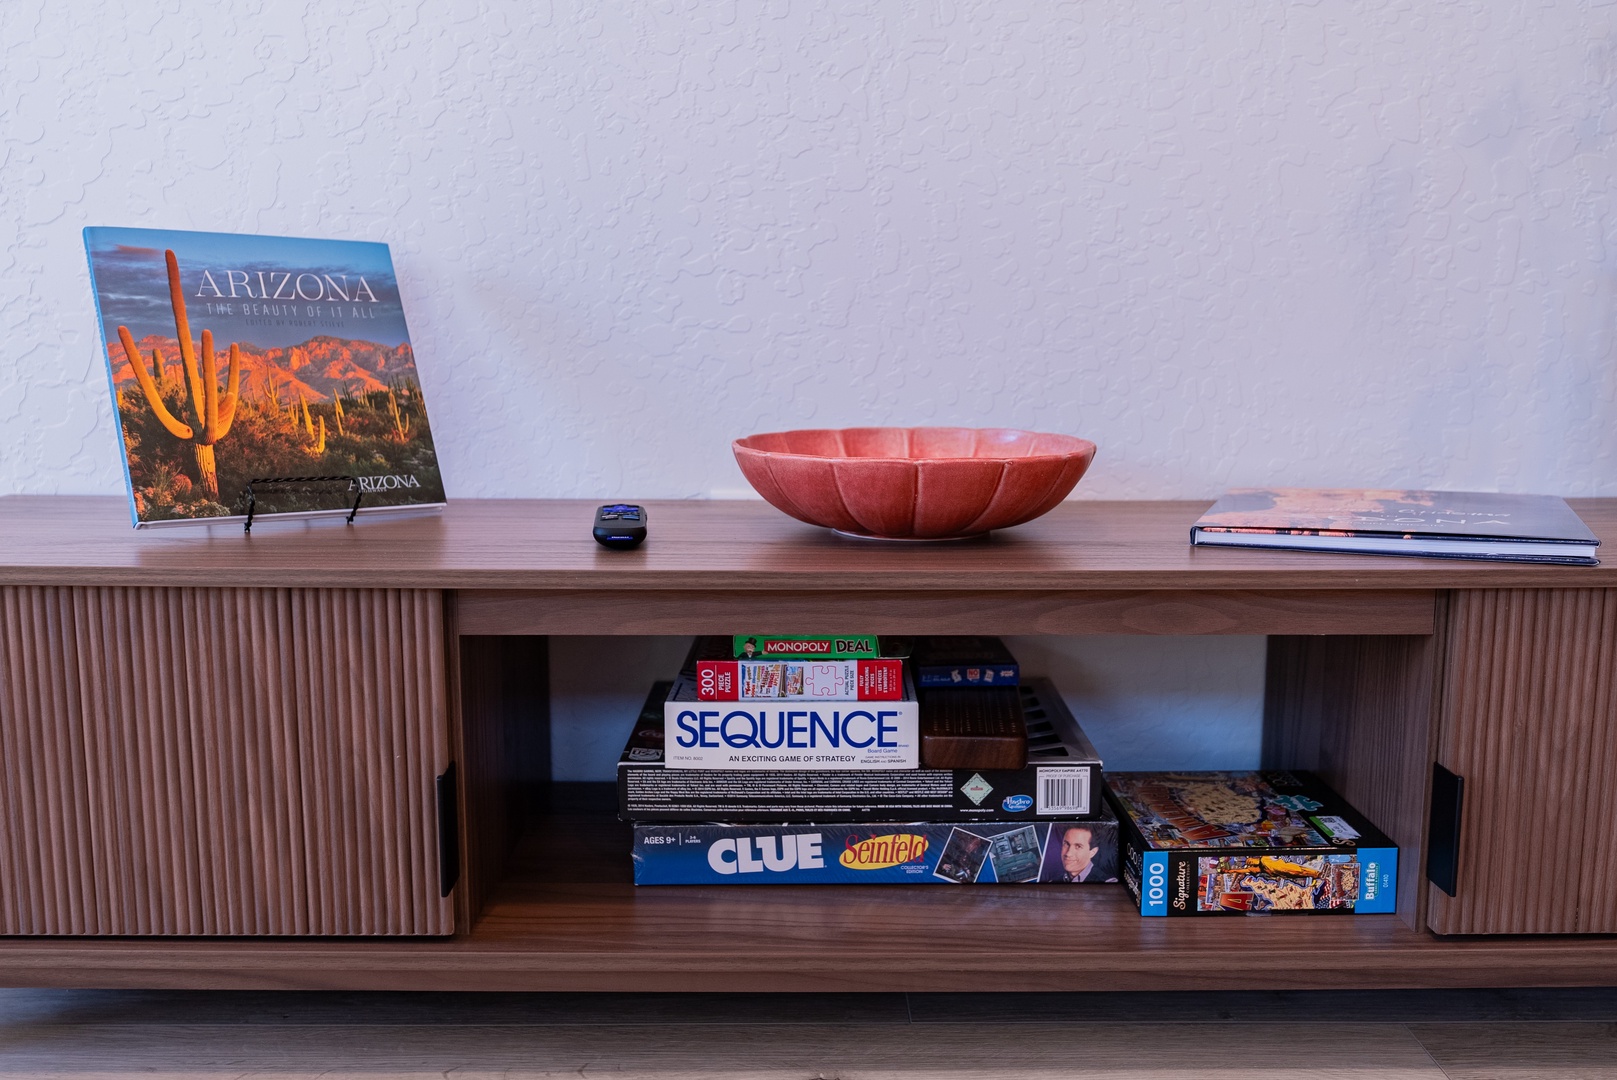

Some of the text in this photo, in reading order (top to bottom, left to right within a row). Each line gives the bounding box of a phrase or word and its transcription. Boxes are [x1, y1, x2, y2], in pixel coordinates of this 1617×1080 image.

[194, 269, 380, 303] ARIZONA
[205, 302, 376, 319] THE BEAUTY OF IT ALL
[767, 639, 873, 653] MONOPOLY DEAL
[701, 669, 714, 696] 300
[724, 671, 732, 693] PUZZLE
[676, 710, 898, 748] SEQUENCE
[741, 755, 778, 763] EXCITING
[779, 755, 801, 763] GAME
[803, 755, 814, 763] OF
[644, 837, 665, 845] AGES
[707, 833, 825, 875] CLUE
[843, 834, 928, 864] Seinfeld
[1149, 862, 1165, 907] 1000
[1172, 860, 1189, 911] Signature
[1365, 862, 1376, 900] Buffalo
